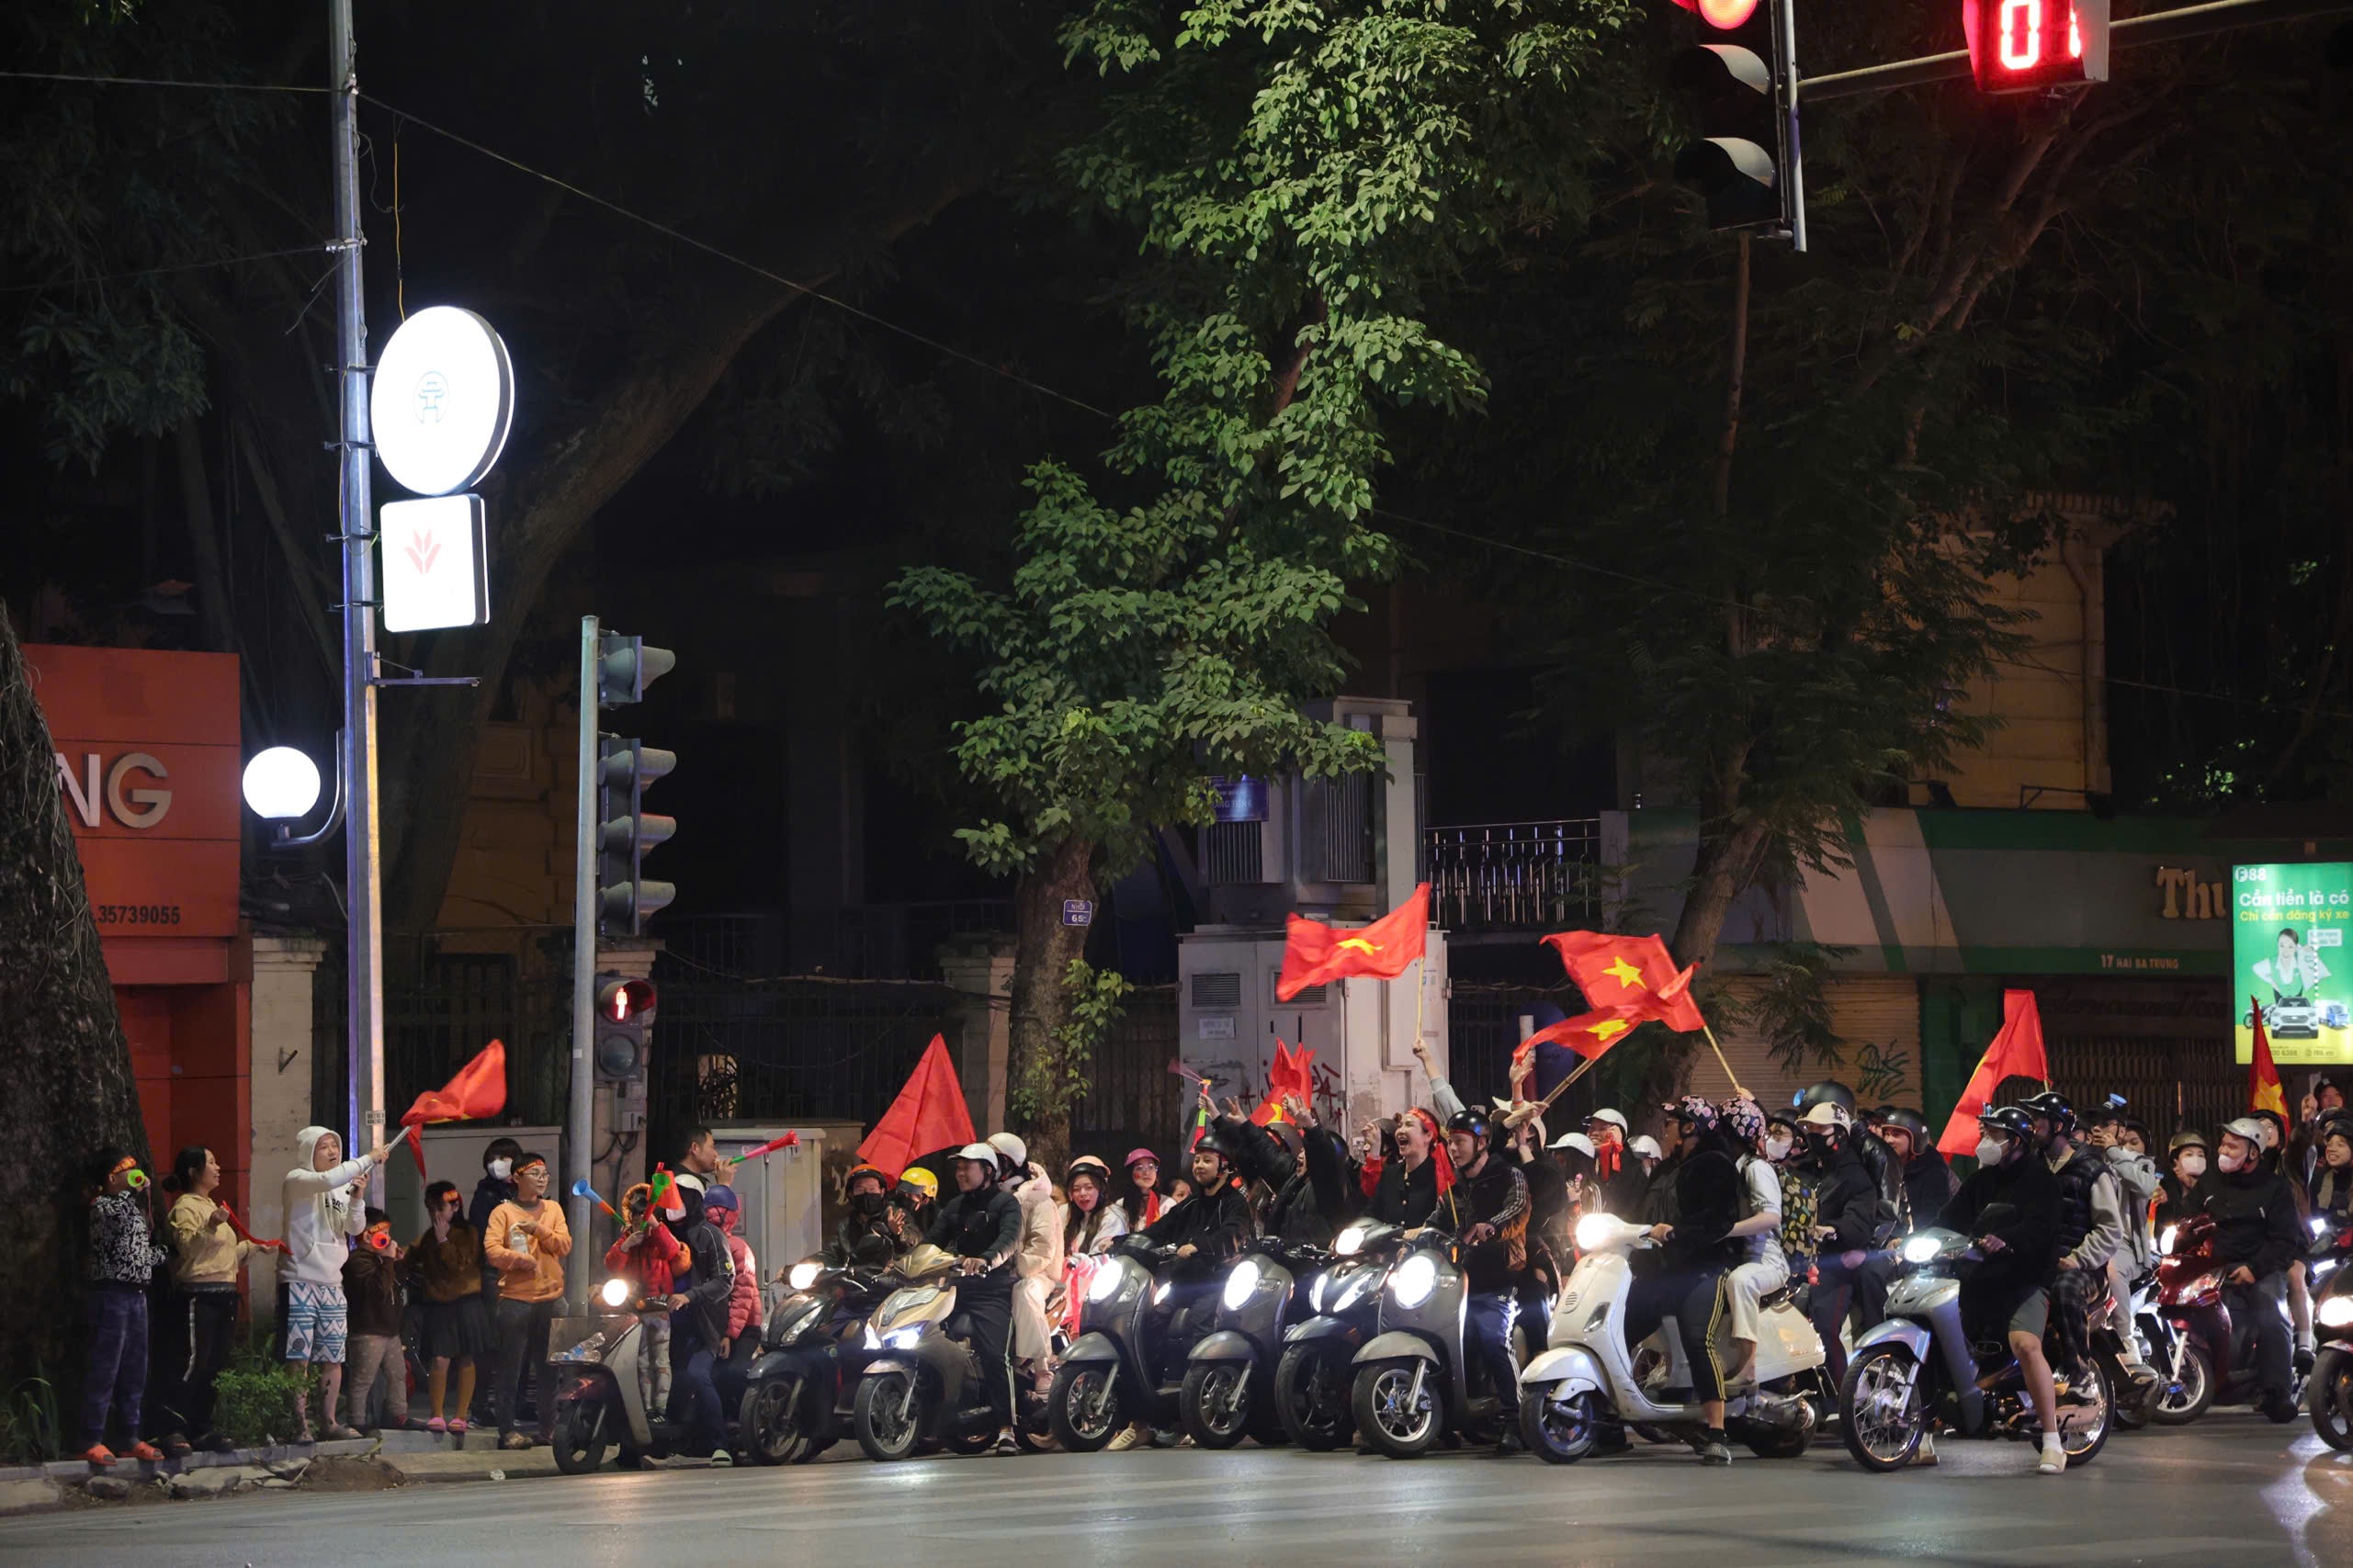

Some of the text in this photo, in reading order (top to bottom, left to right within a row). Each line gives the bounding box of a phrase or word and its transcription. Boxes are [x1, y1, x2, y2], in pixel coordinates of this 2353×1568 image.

[55, 752, 172, 829] NG
[2234, 867, 2267, 882] F88
[2276, 888, 2304, 905] tiền
[2309, 890, 2325, 905] là
[2329, 889, 2349, 905] có
[2286, 909, 2316, 923] đăng
[2319, 908, 2332, 921] ký
[2336, 910, 2349, 919] xe
[2101, 953, 2114, 968] 17
